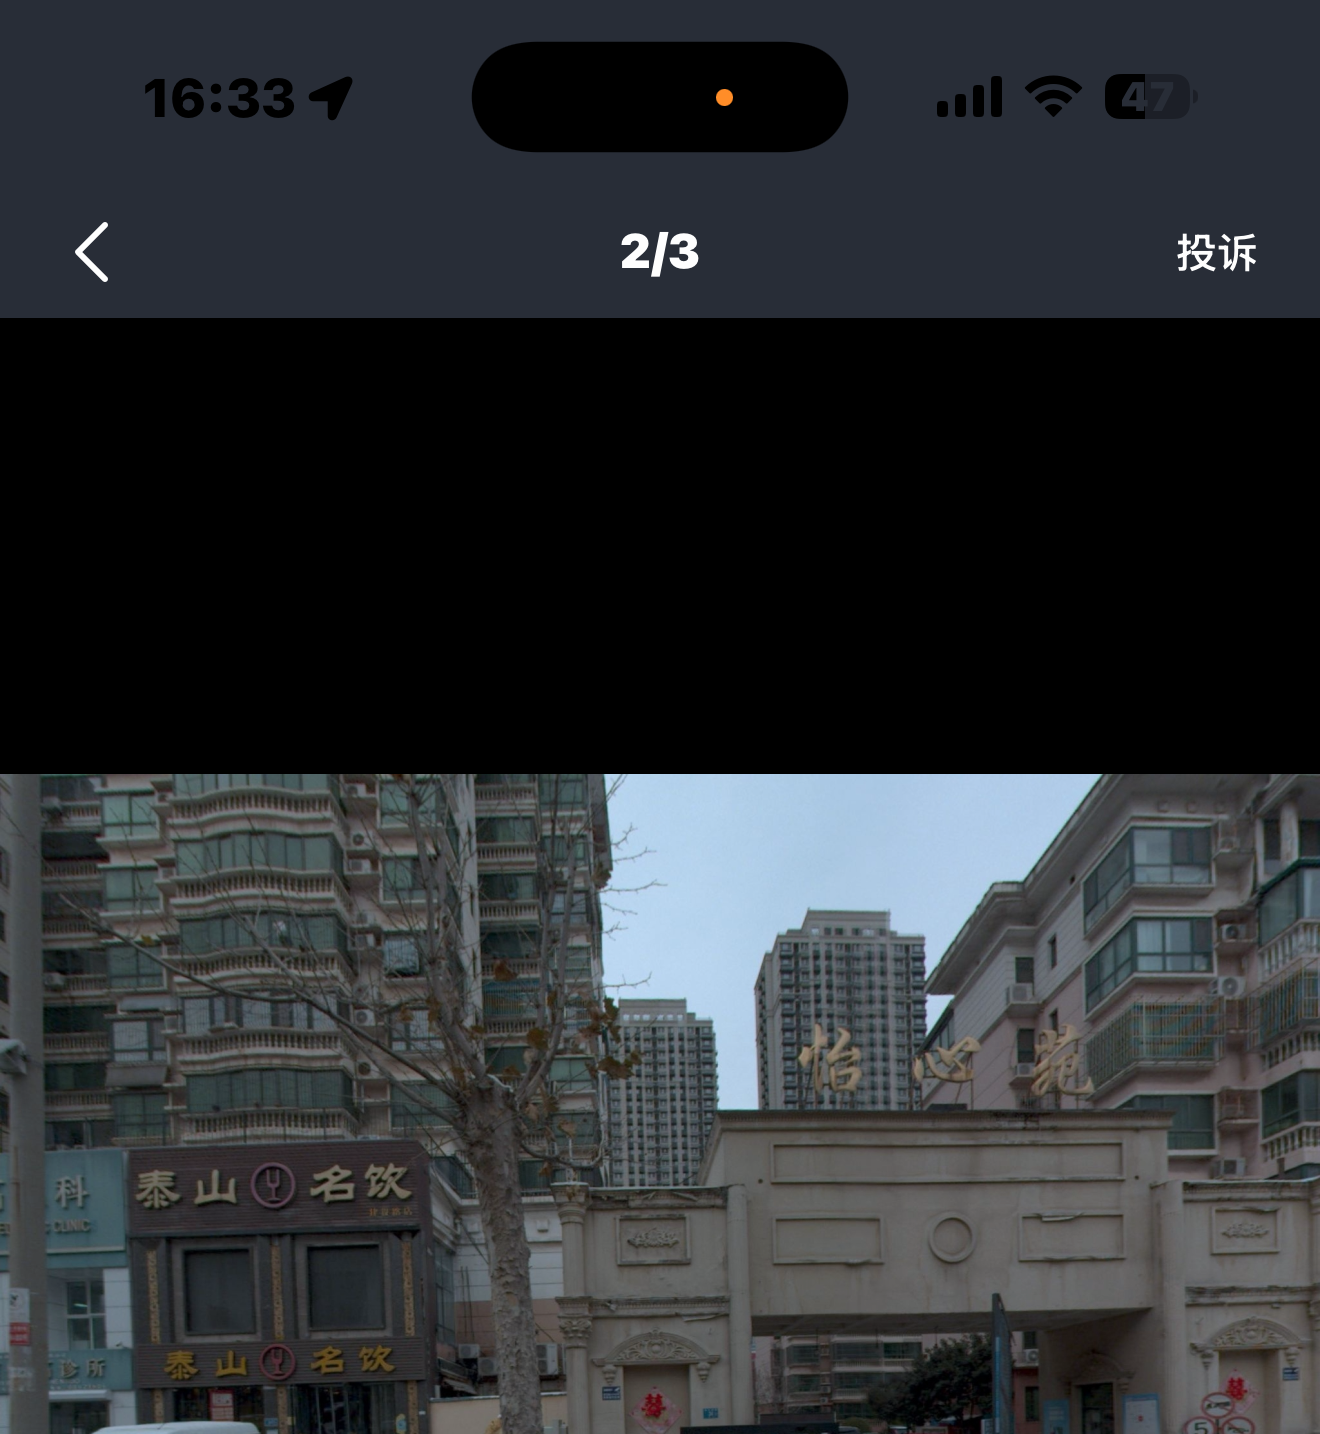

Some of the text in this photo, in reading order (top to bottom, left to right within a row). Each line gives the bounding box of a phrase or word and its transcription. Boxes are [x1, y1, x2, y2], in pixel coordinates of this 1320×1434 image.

[799, 1024, 1093, 1096] 怡心苑
[53, 1218, 92, 1234] CLINIC
[48, 1357, 107, 1379] 诊所
